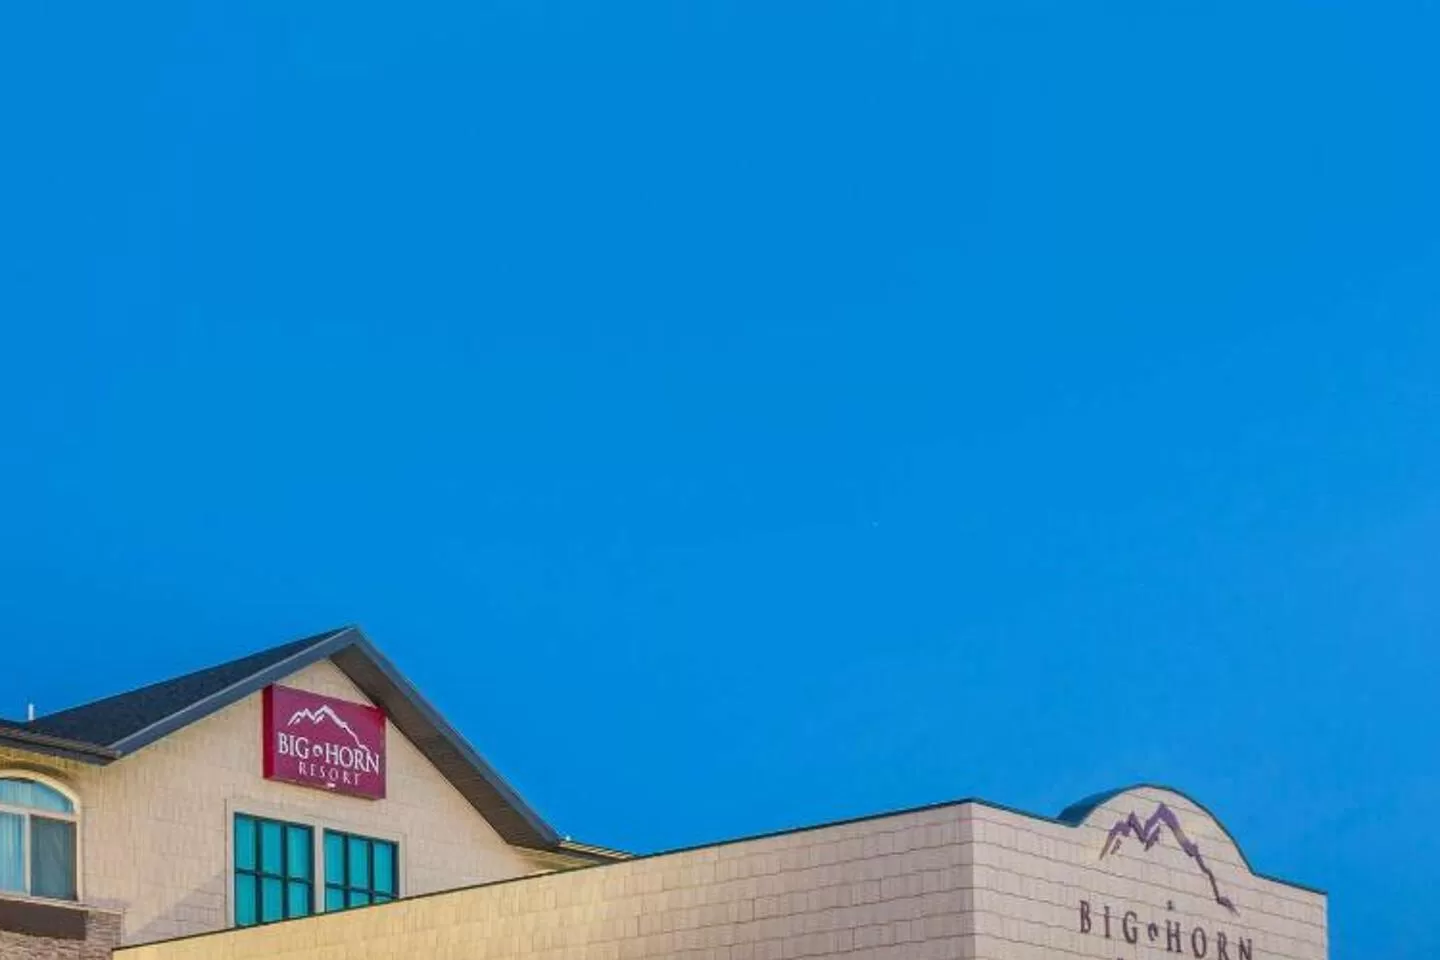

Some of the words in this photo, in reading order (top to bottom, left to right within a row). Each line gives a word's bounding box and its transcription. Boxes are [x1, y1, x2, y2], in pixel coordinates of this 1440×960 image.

[278, 732, 309, 760] BIG
[325, 742, 380, 774] HORN
[299, 762, 361, 785] RESORT
[1080, 900, 1138, 944] BIG
